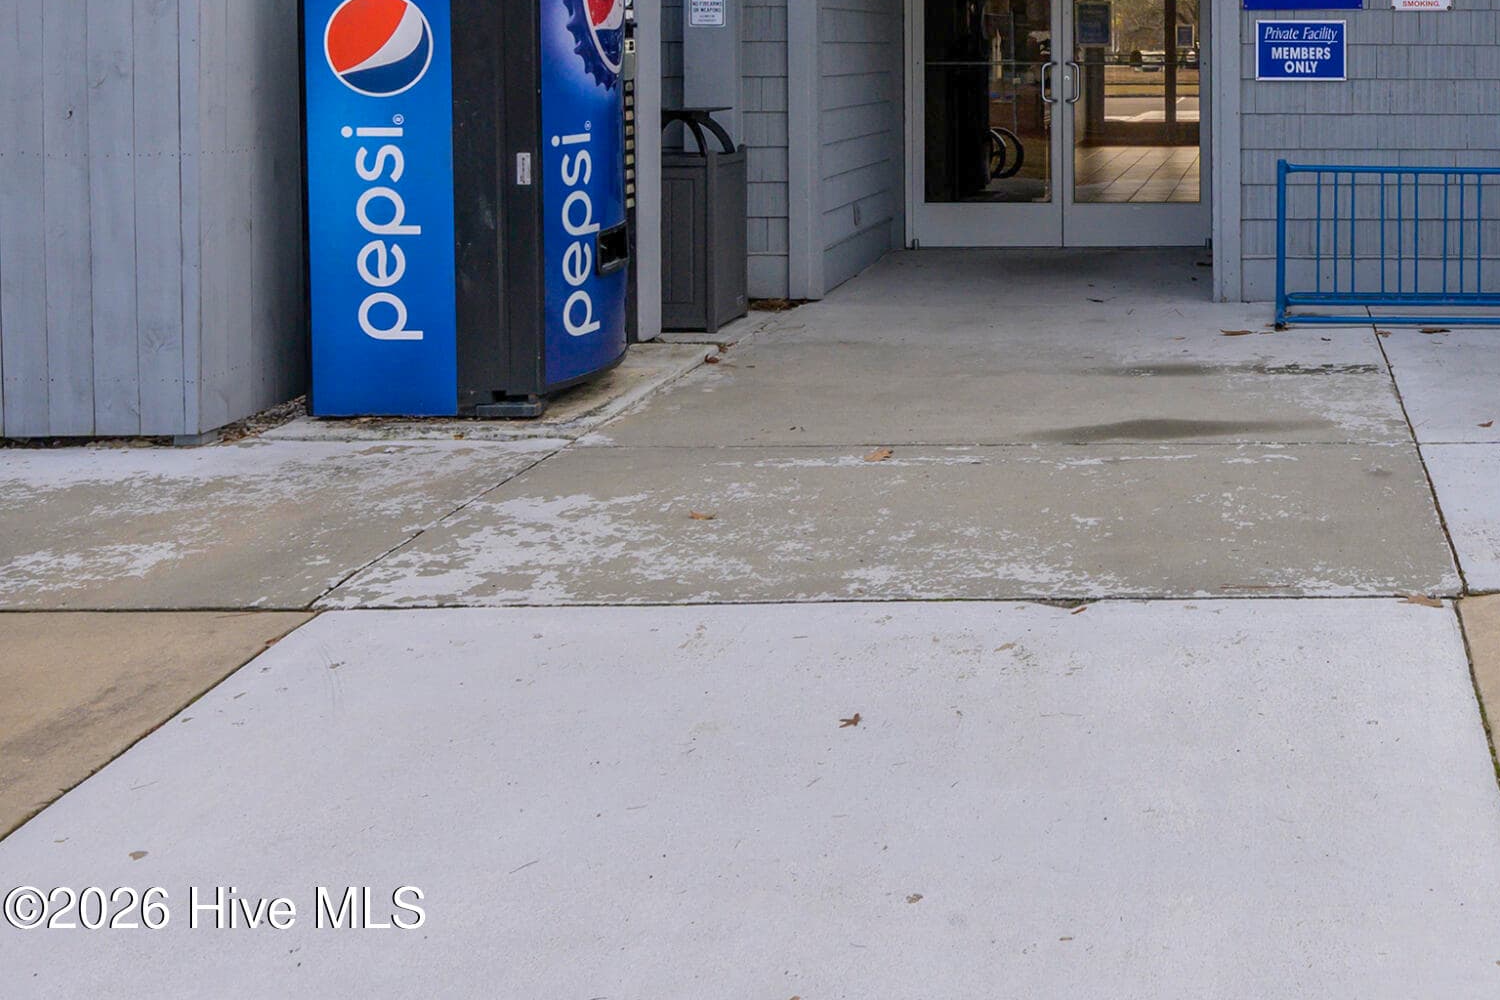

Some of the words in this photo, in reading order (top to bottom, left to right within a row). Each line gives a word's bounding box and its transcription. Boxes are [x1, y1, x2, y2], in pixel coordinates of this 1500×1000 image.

[1264, 26, 1299, 40] Private
[1302, 26, 1338, 44] Facility
[1271, 47, 1331, 60] MEMBERS
[1284, 61, 1318, 73] ONLY
